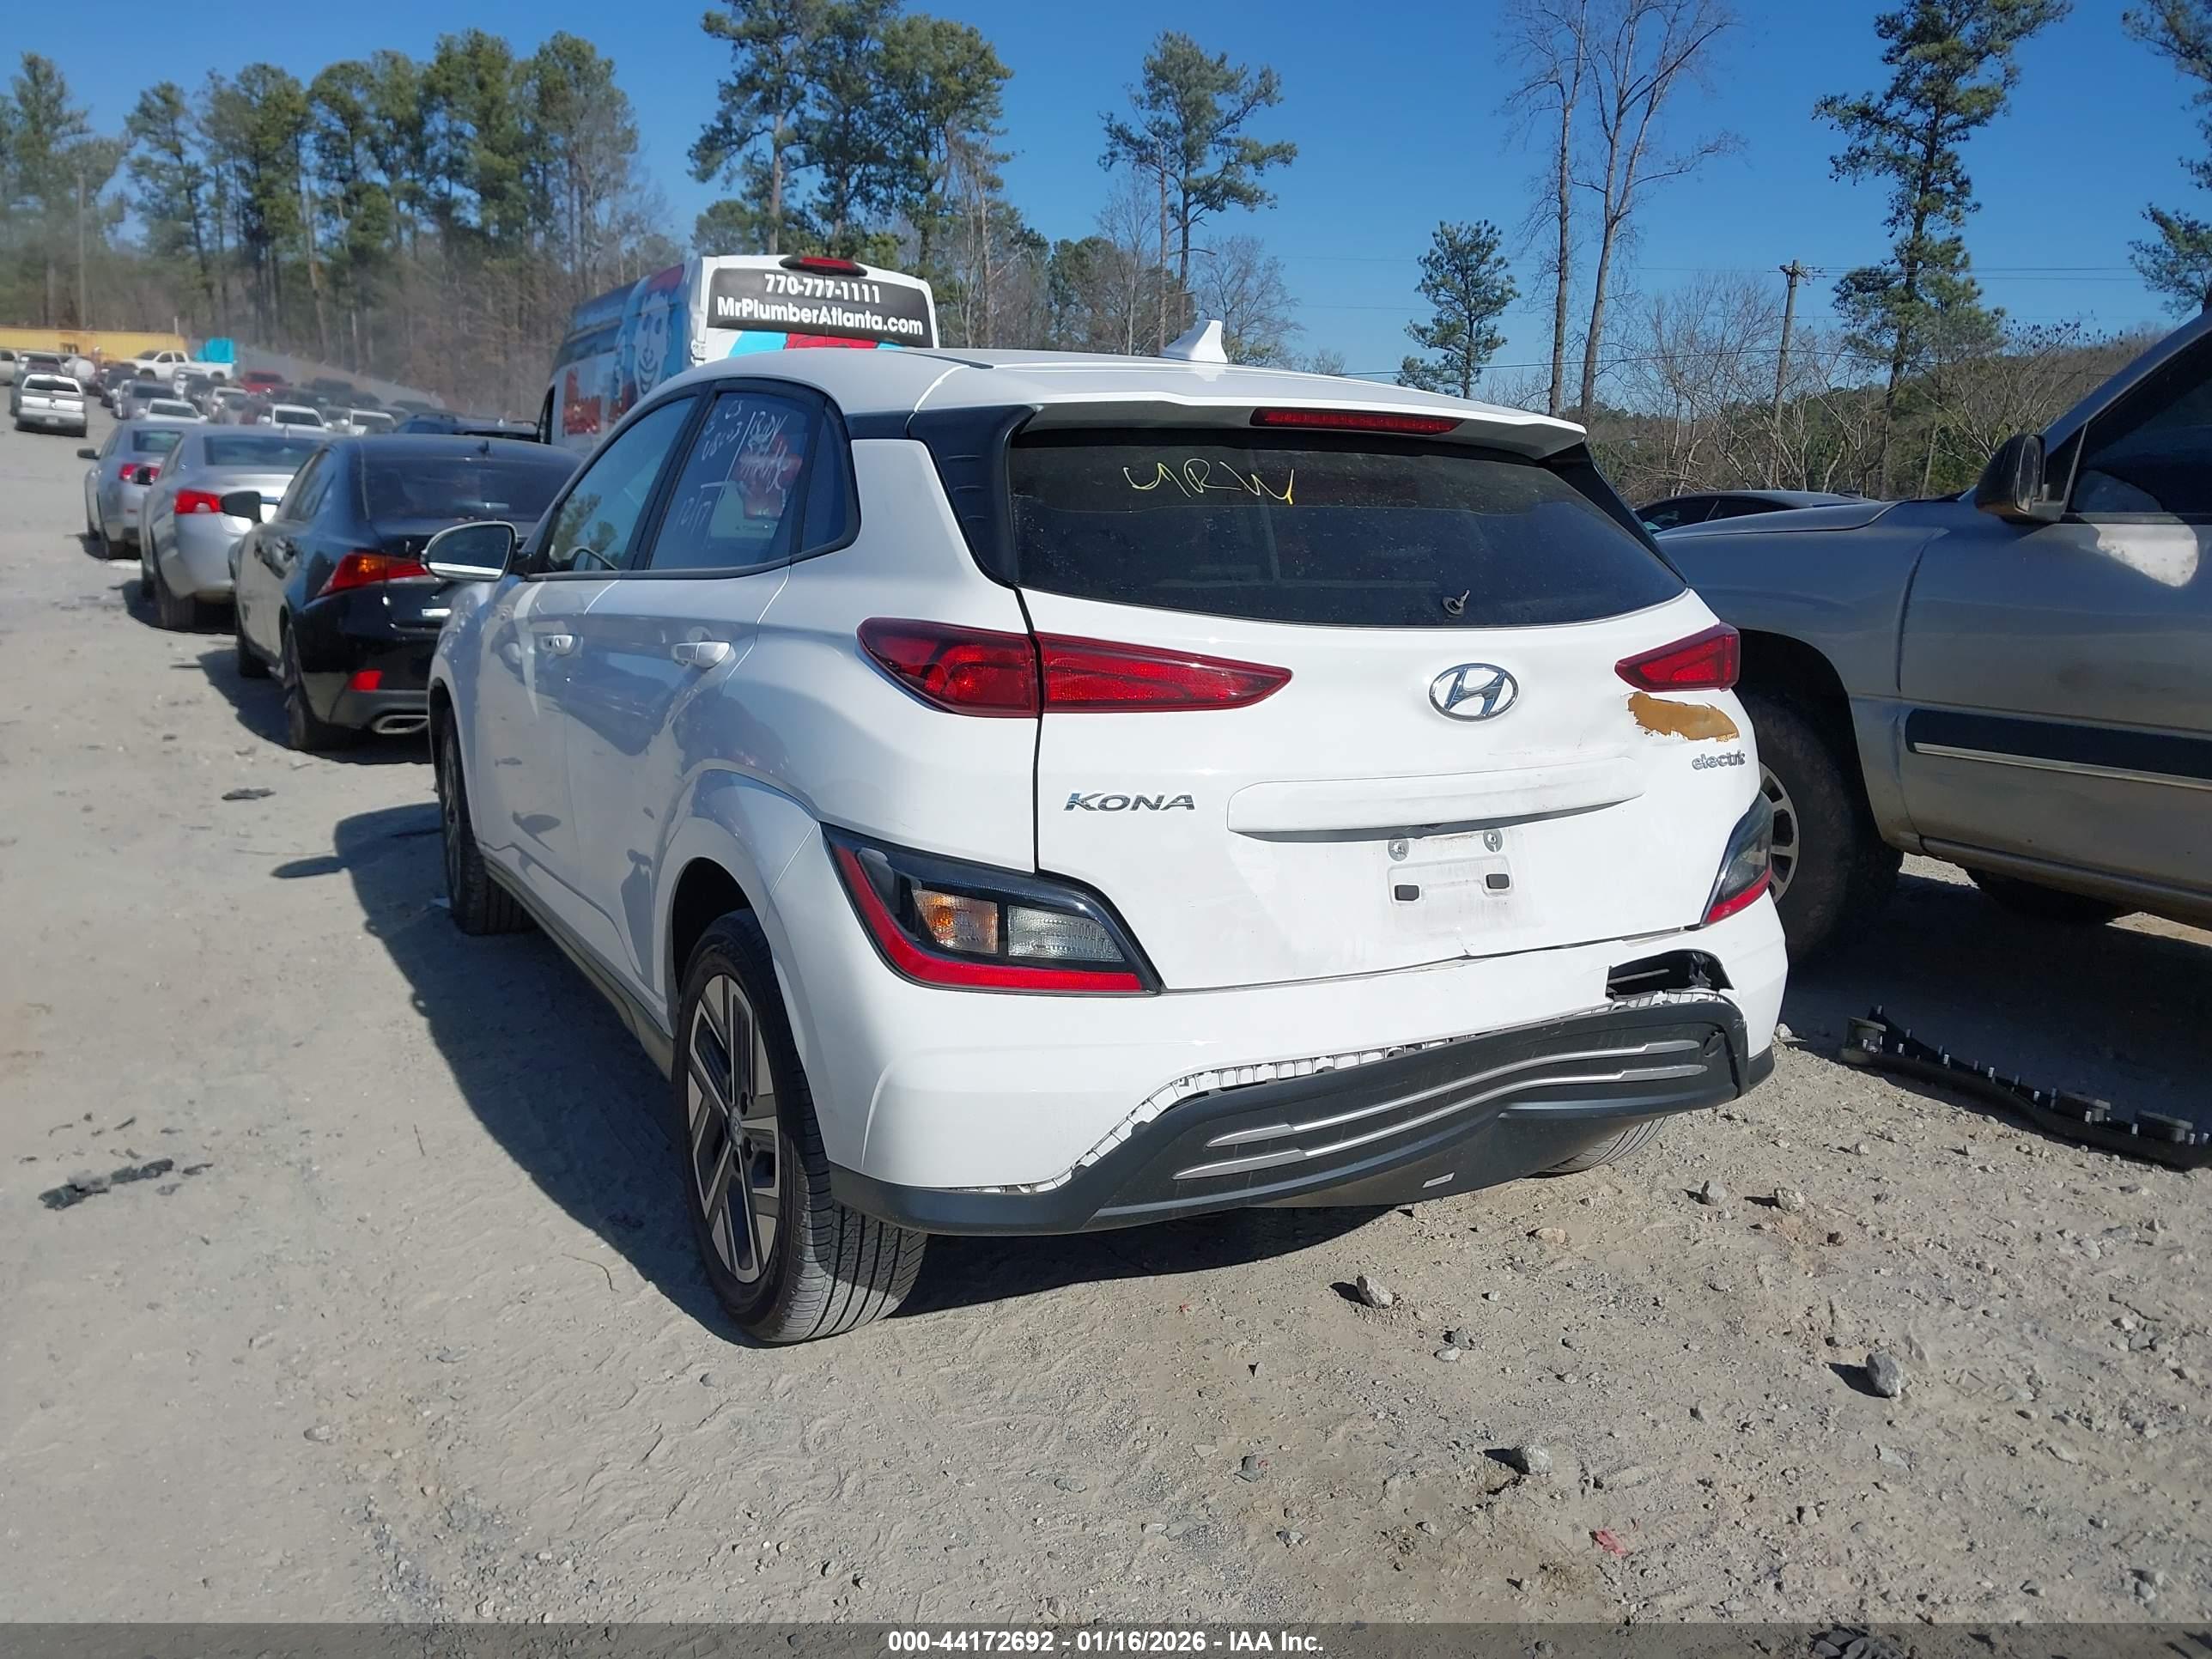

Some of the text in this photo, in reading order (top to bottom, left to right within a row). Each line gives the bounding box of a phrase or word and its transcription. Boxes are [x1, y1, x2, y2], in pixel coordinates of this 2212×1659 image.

[764, 273, 880, 304] 770-777-1111
[717, 296, 923, 336] MrPlumberAtlanta.com
[1064, 793, 1195, 811] KONA
